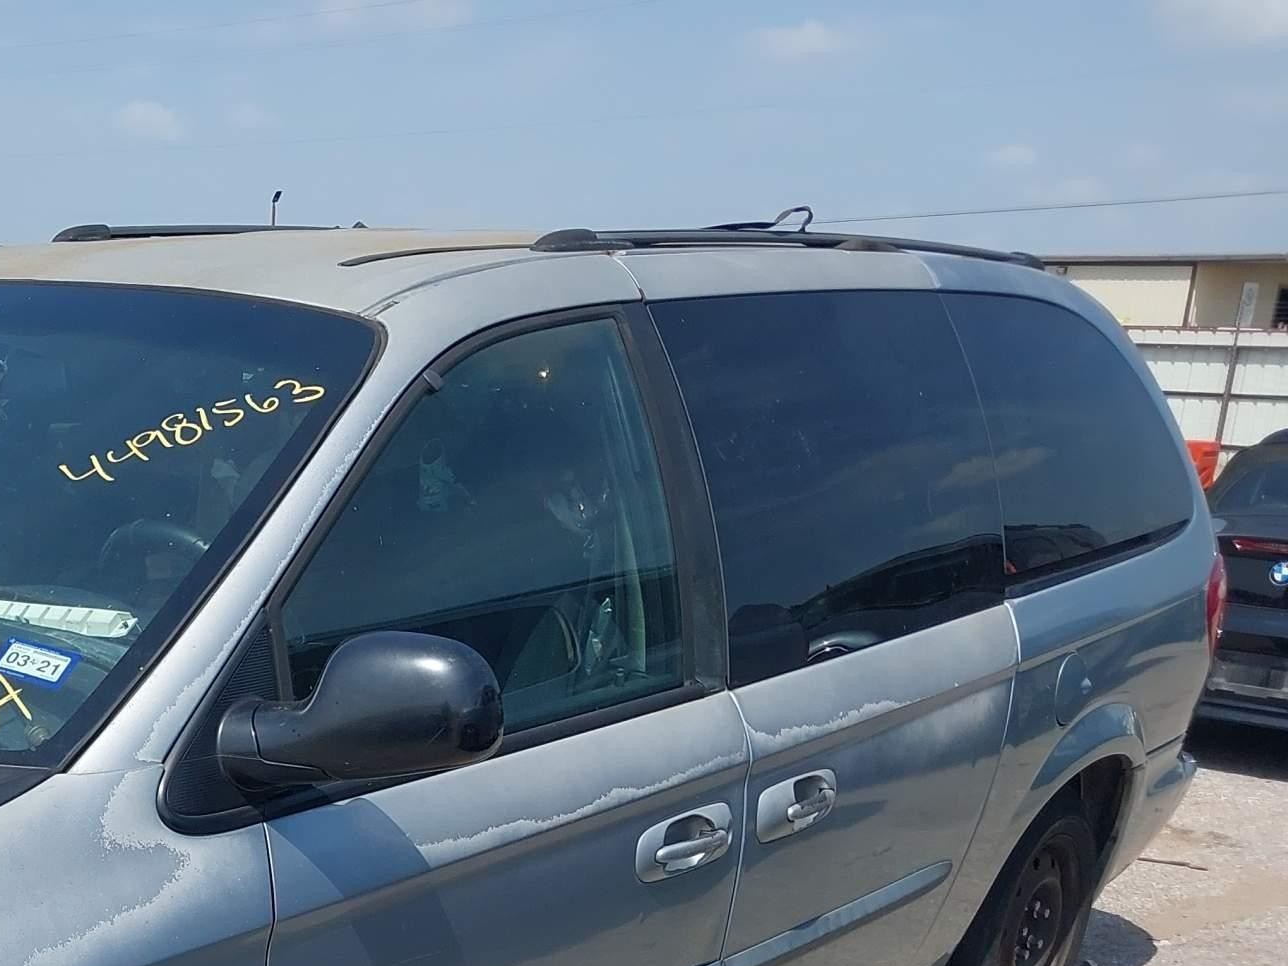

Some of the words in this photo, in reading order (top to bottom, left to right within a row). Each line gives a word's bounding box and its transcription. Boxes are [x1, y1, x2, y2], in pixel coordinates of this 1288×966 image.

[58, 379, 325, 482] 44981563
[6, 651, 31, 667] 03
[35, 660, 61, 676] 21
